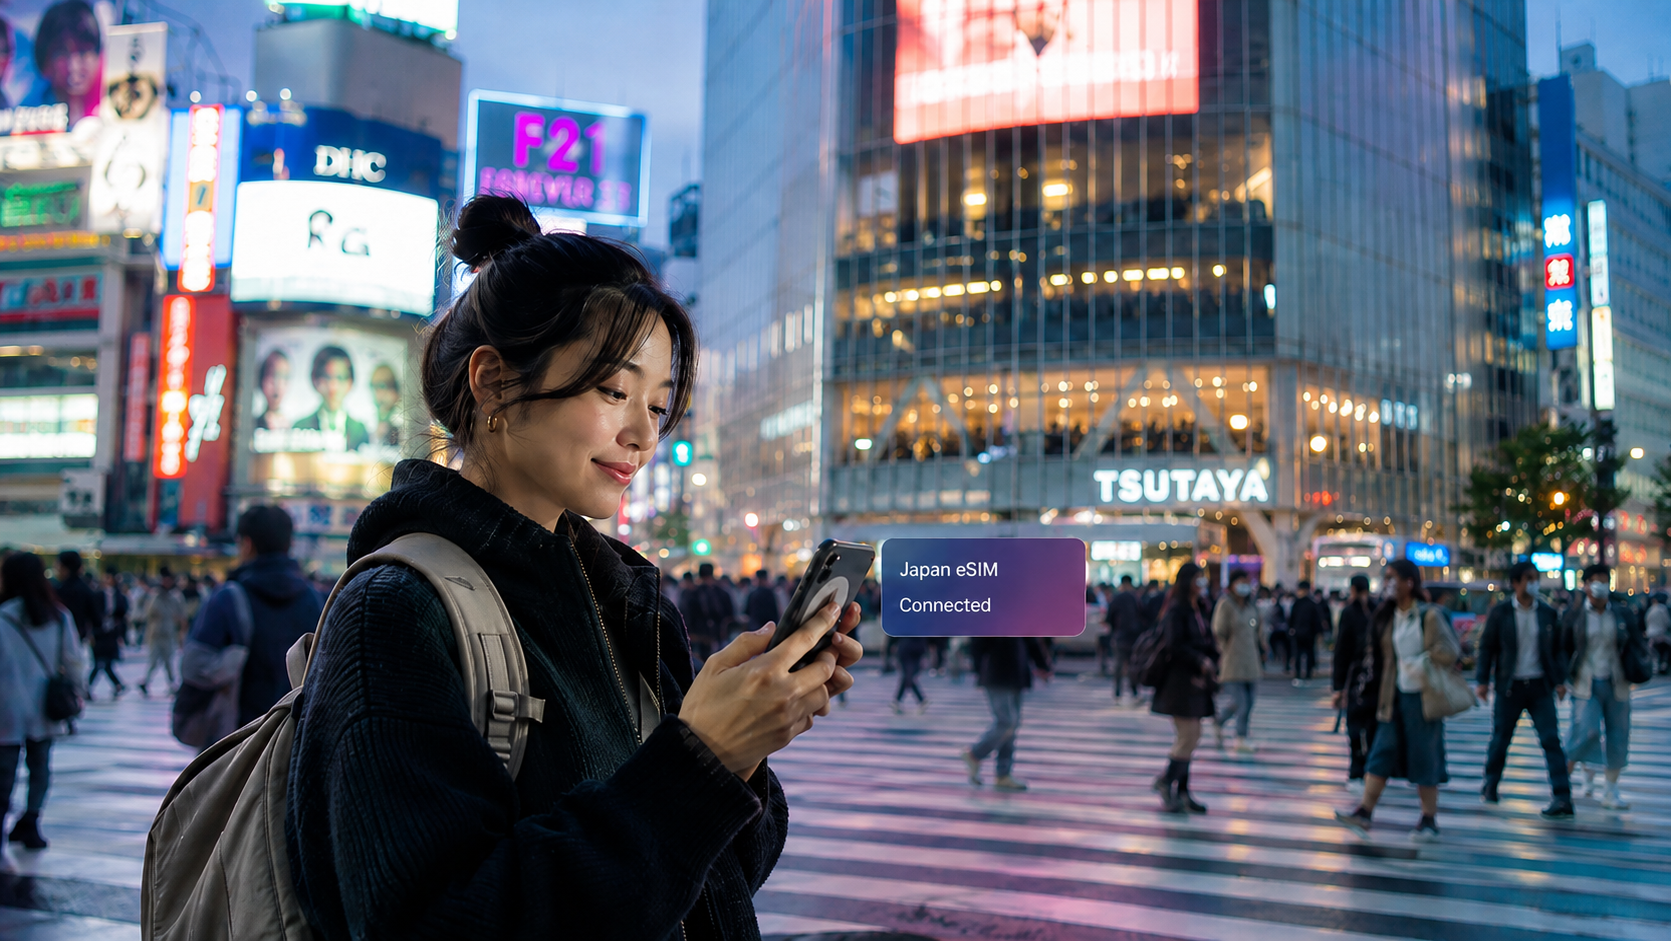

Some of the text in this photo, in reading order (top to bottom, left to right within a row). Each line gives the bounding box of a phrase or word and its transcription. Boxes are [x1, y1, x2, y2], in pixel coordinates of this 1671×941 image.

[514, 111, 606, 176] F21
[313, 145, 387, 183] DHC
[1093, 468, 1269, 503] TSUTAYA
